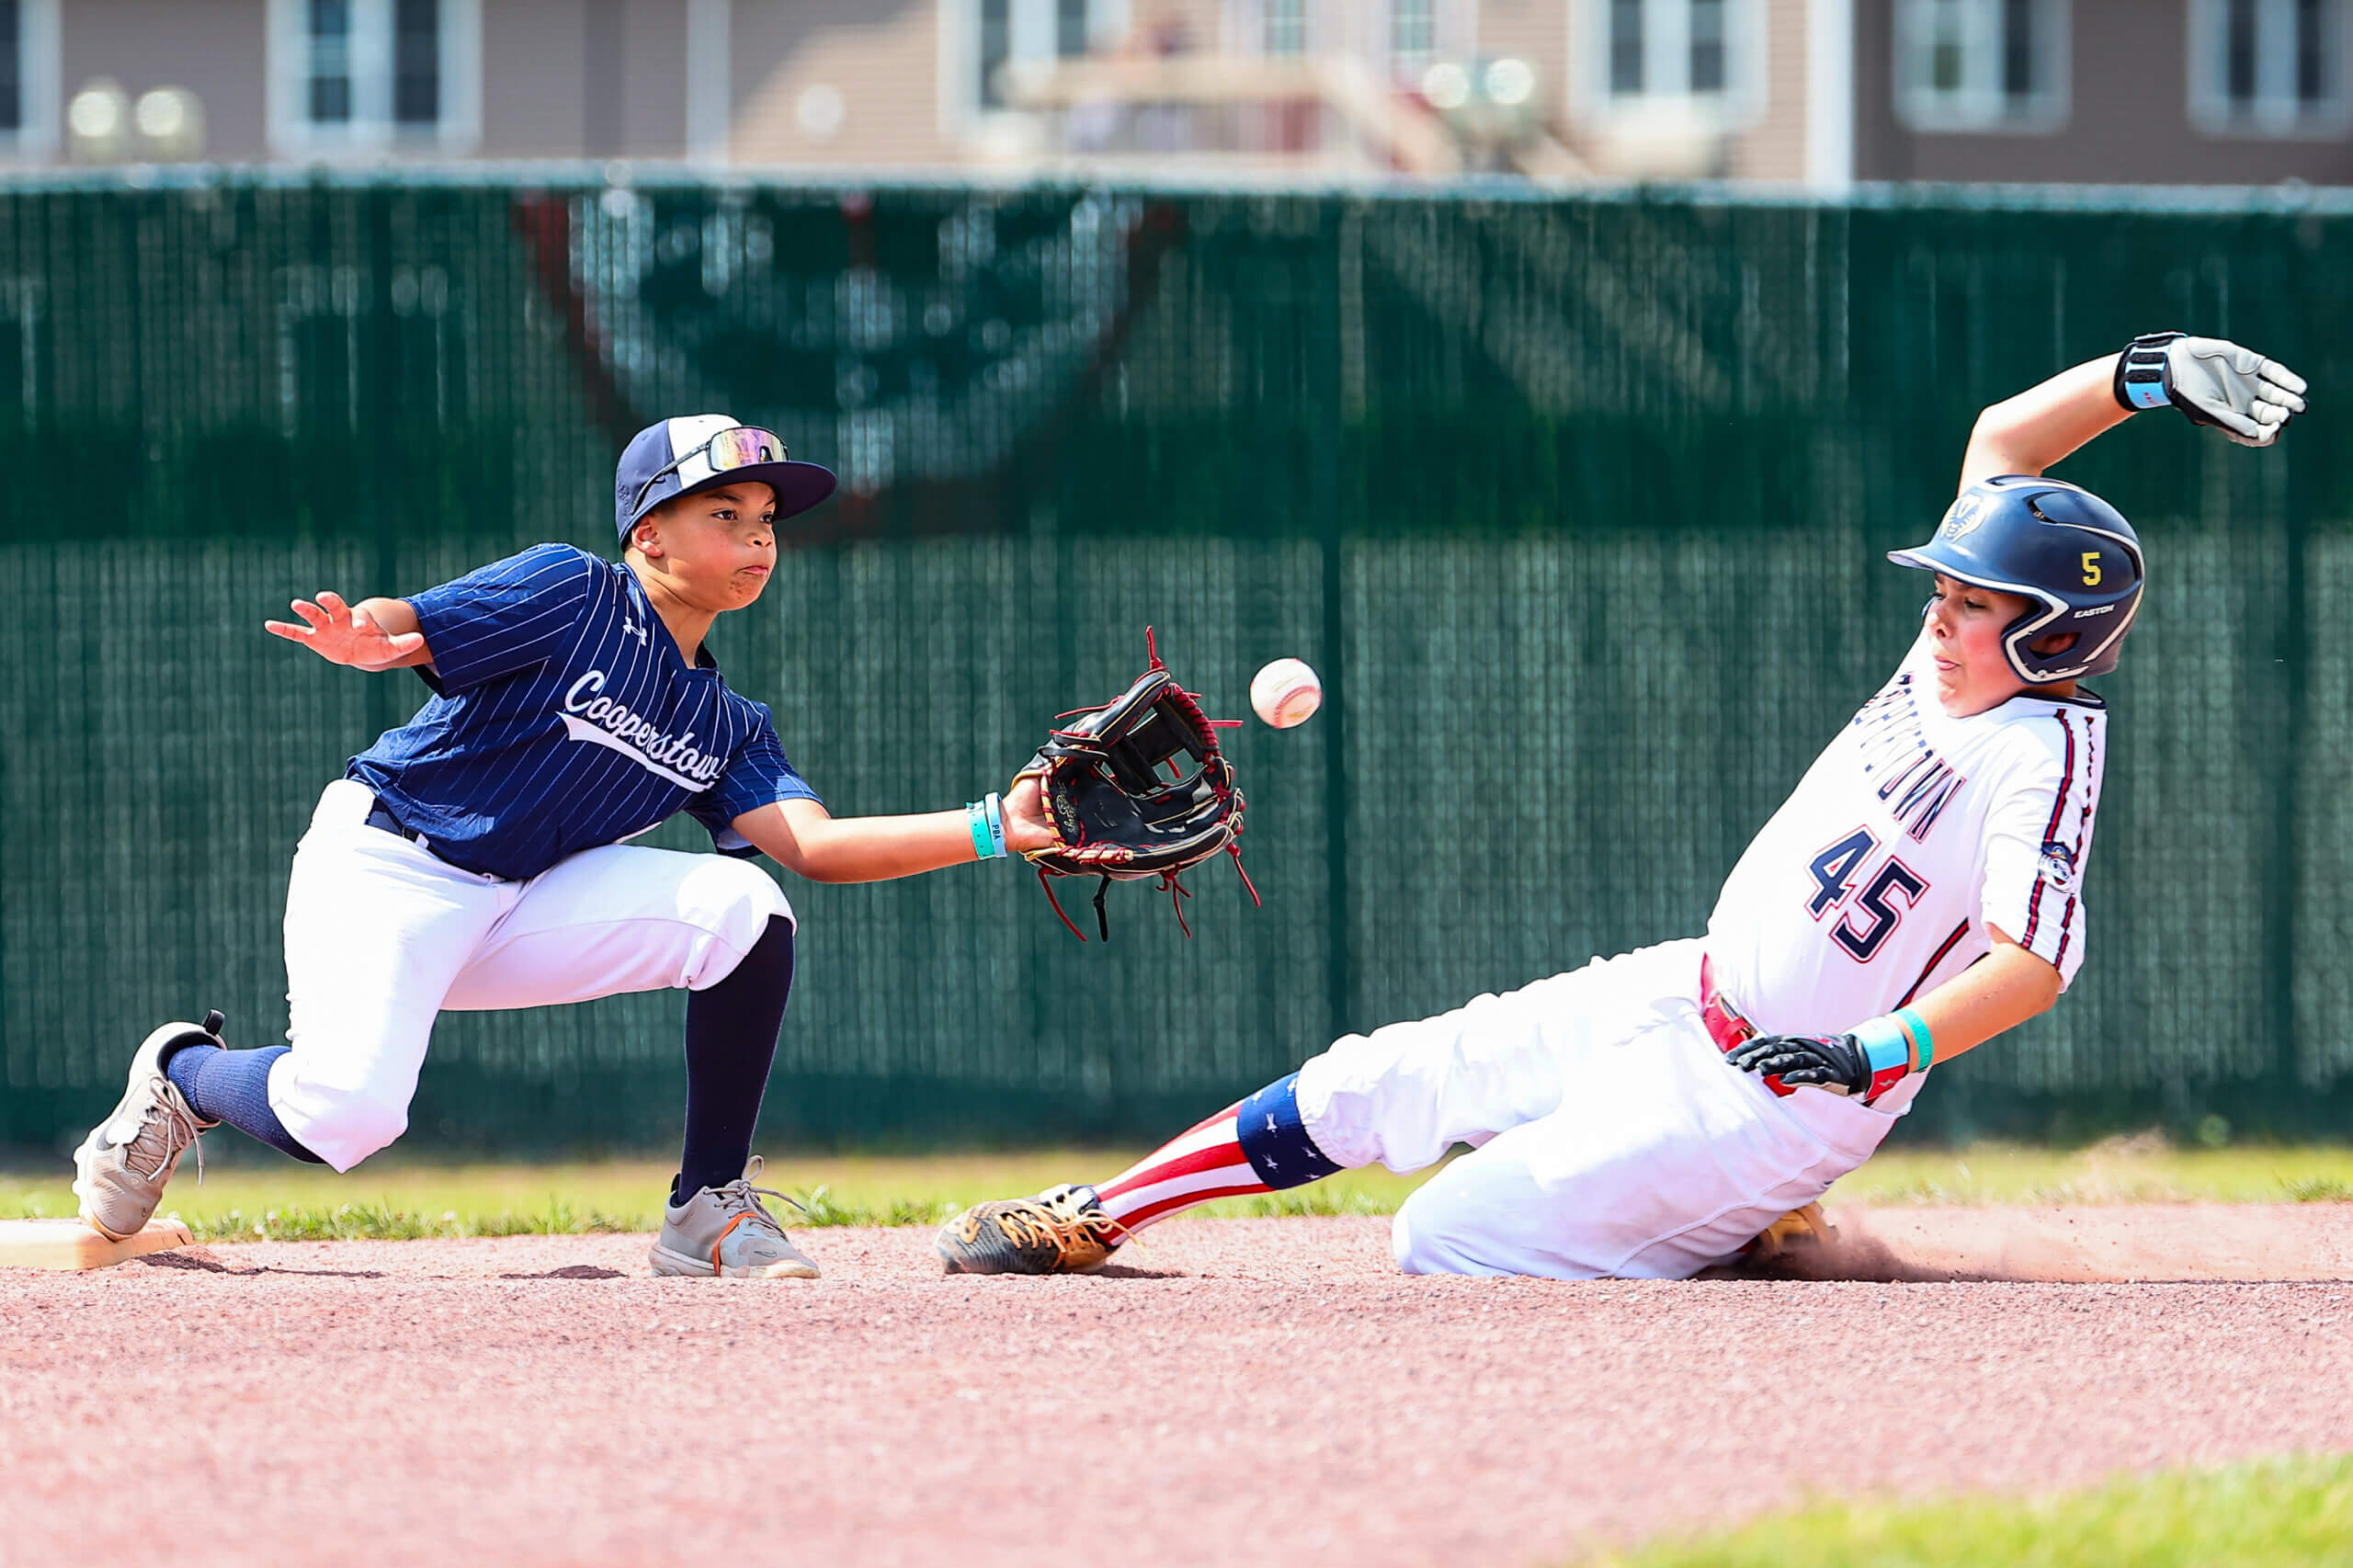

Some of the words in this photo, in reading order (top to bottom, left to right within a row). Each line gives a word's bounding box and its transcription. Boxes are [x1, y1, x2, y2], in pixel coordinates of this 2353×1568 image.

[2080, 551, 2102, 587] 5
[2073, 603, 2116, 619] EASTON
[563, 669, 721, 780] Cooperstow
[1803, 823, 1931, 964] 45
